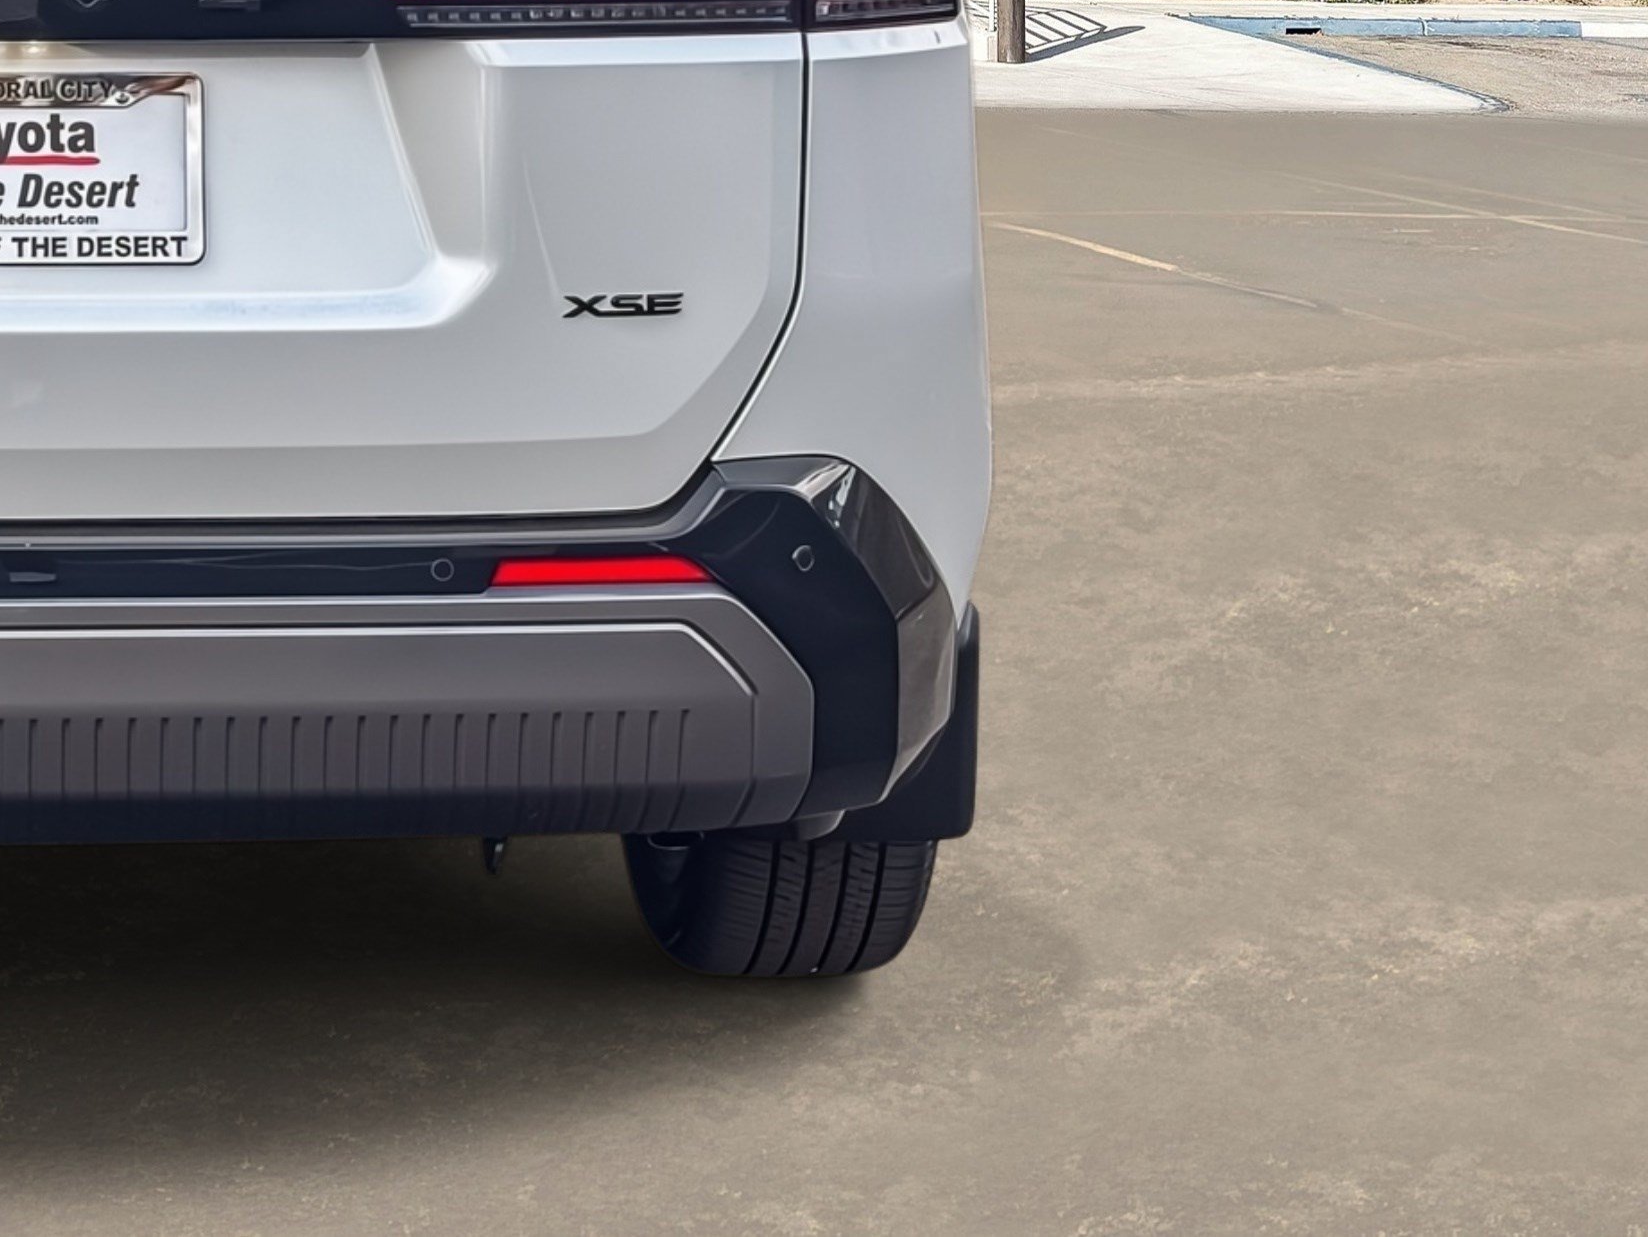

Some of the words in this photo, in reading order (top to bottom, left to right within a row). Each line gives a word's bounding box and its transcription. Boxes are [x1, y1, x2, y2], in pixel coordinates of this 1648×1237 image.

[56, 79, 114, 101] CITY
[17, 173, 140, 209] Desert
[12, 236, 68, 258] THE
[76, 235, 188, 258] DESERT
[562, 292, 684, 319] XSE
